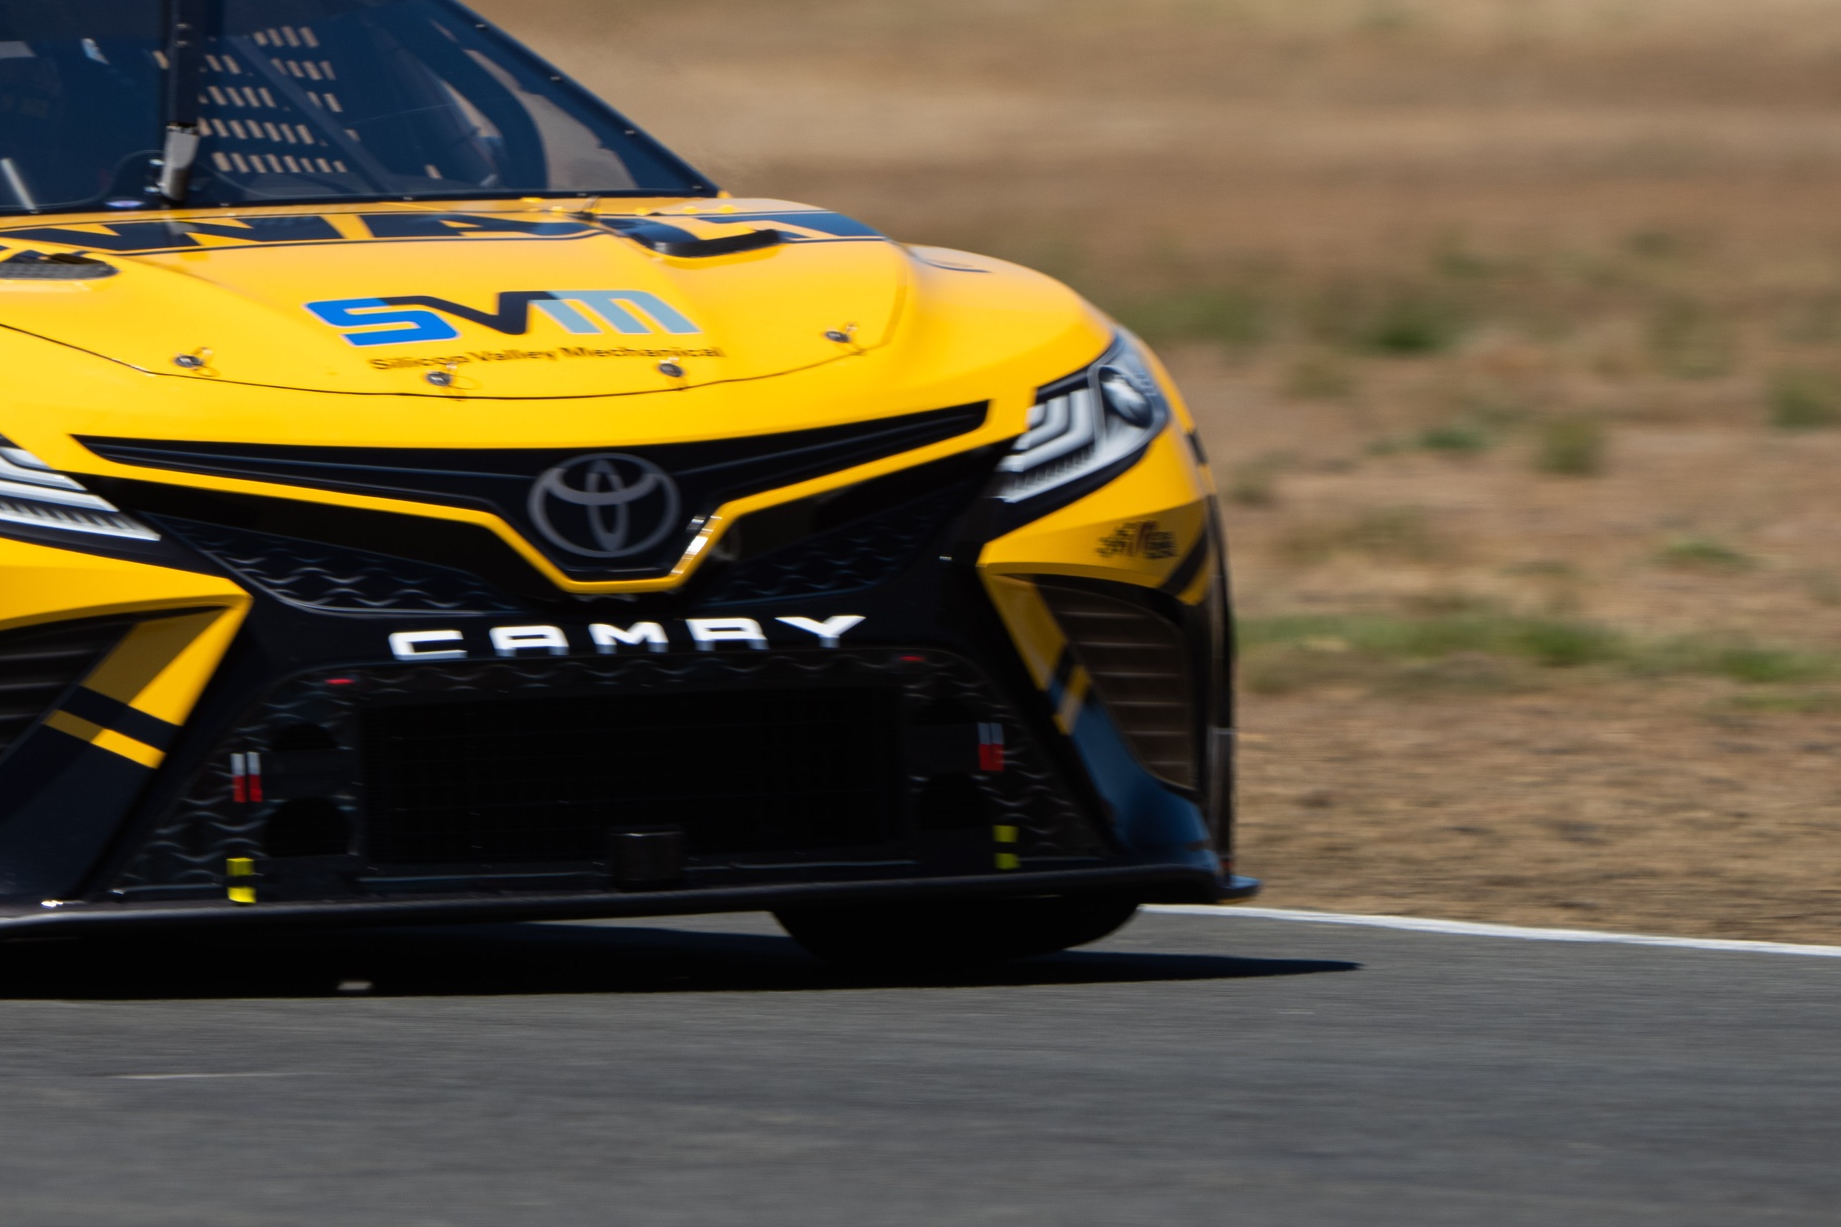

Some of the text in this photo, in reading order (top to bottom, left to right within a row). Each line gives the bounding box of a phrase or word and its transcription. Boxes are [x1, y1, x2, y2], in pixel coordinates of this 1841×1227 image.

[469, 349, 557, 362] Valley
[559, 346, 725, 359] Mechanical
[388, 614, 867, 660] CAMRY
